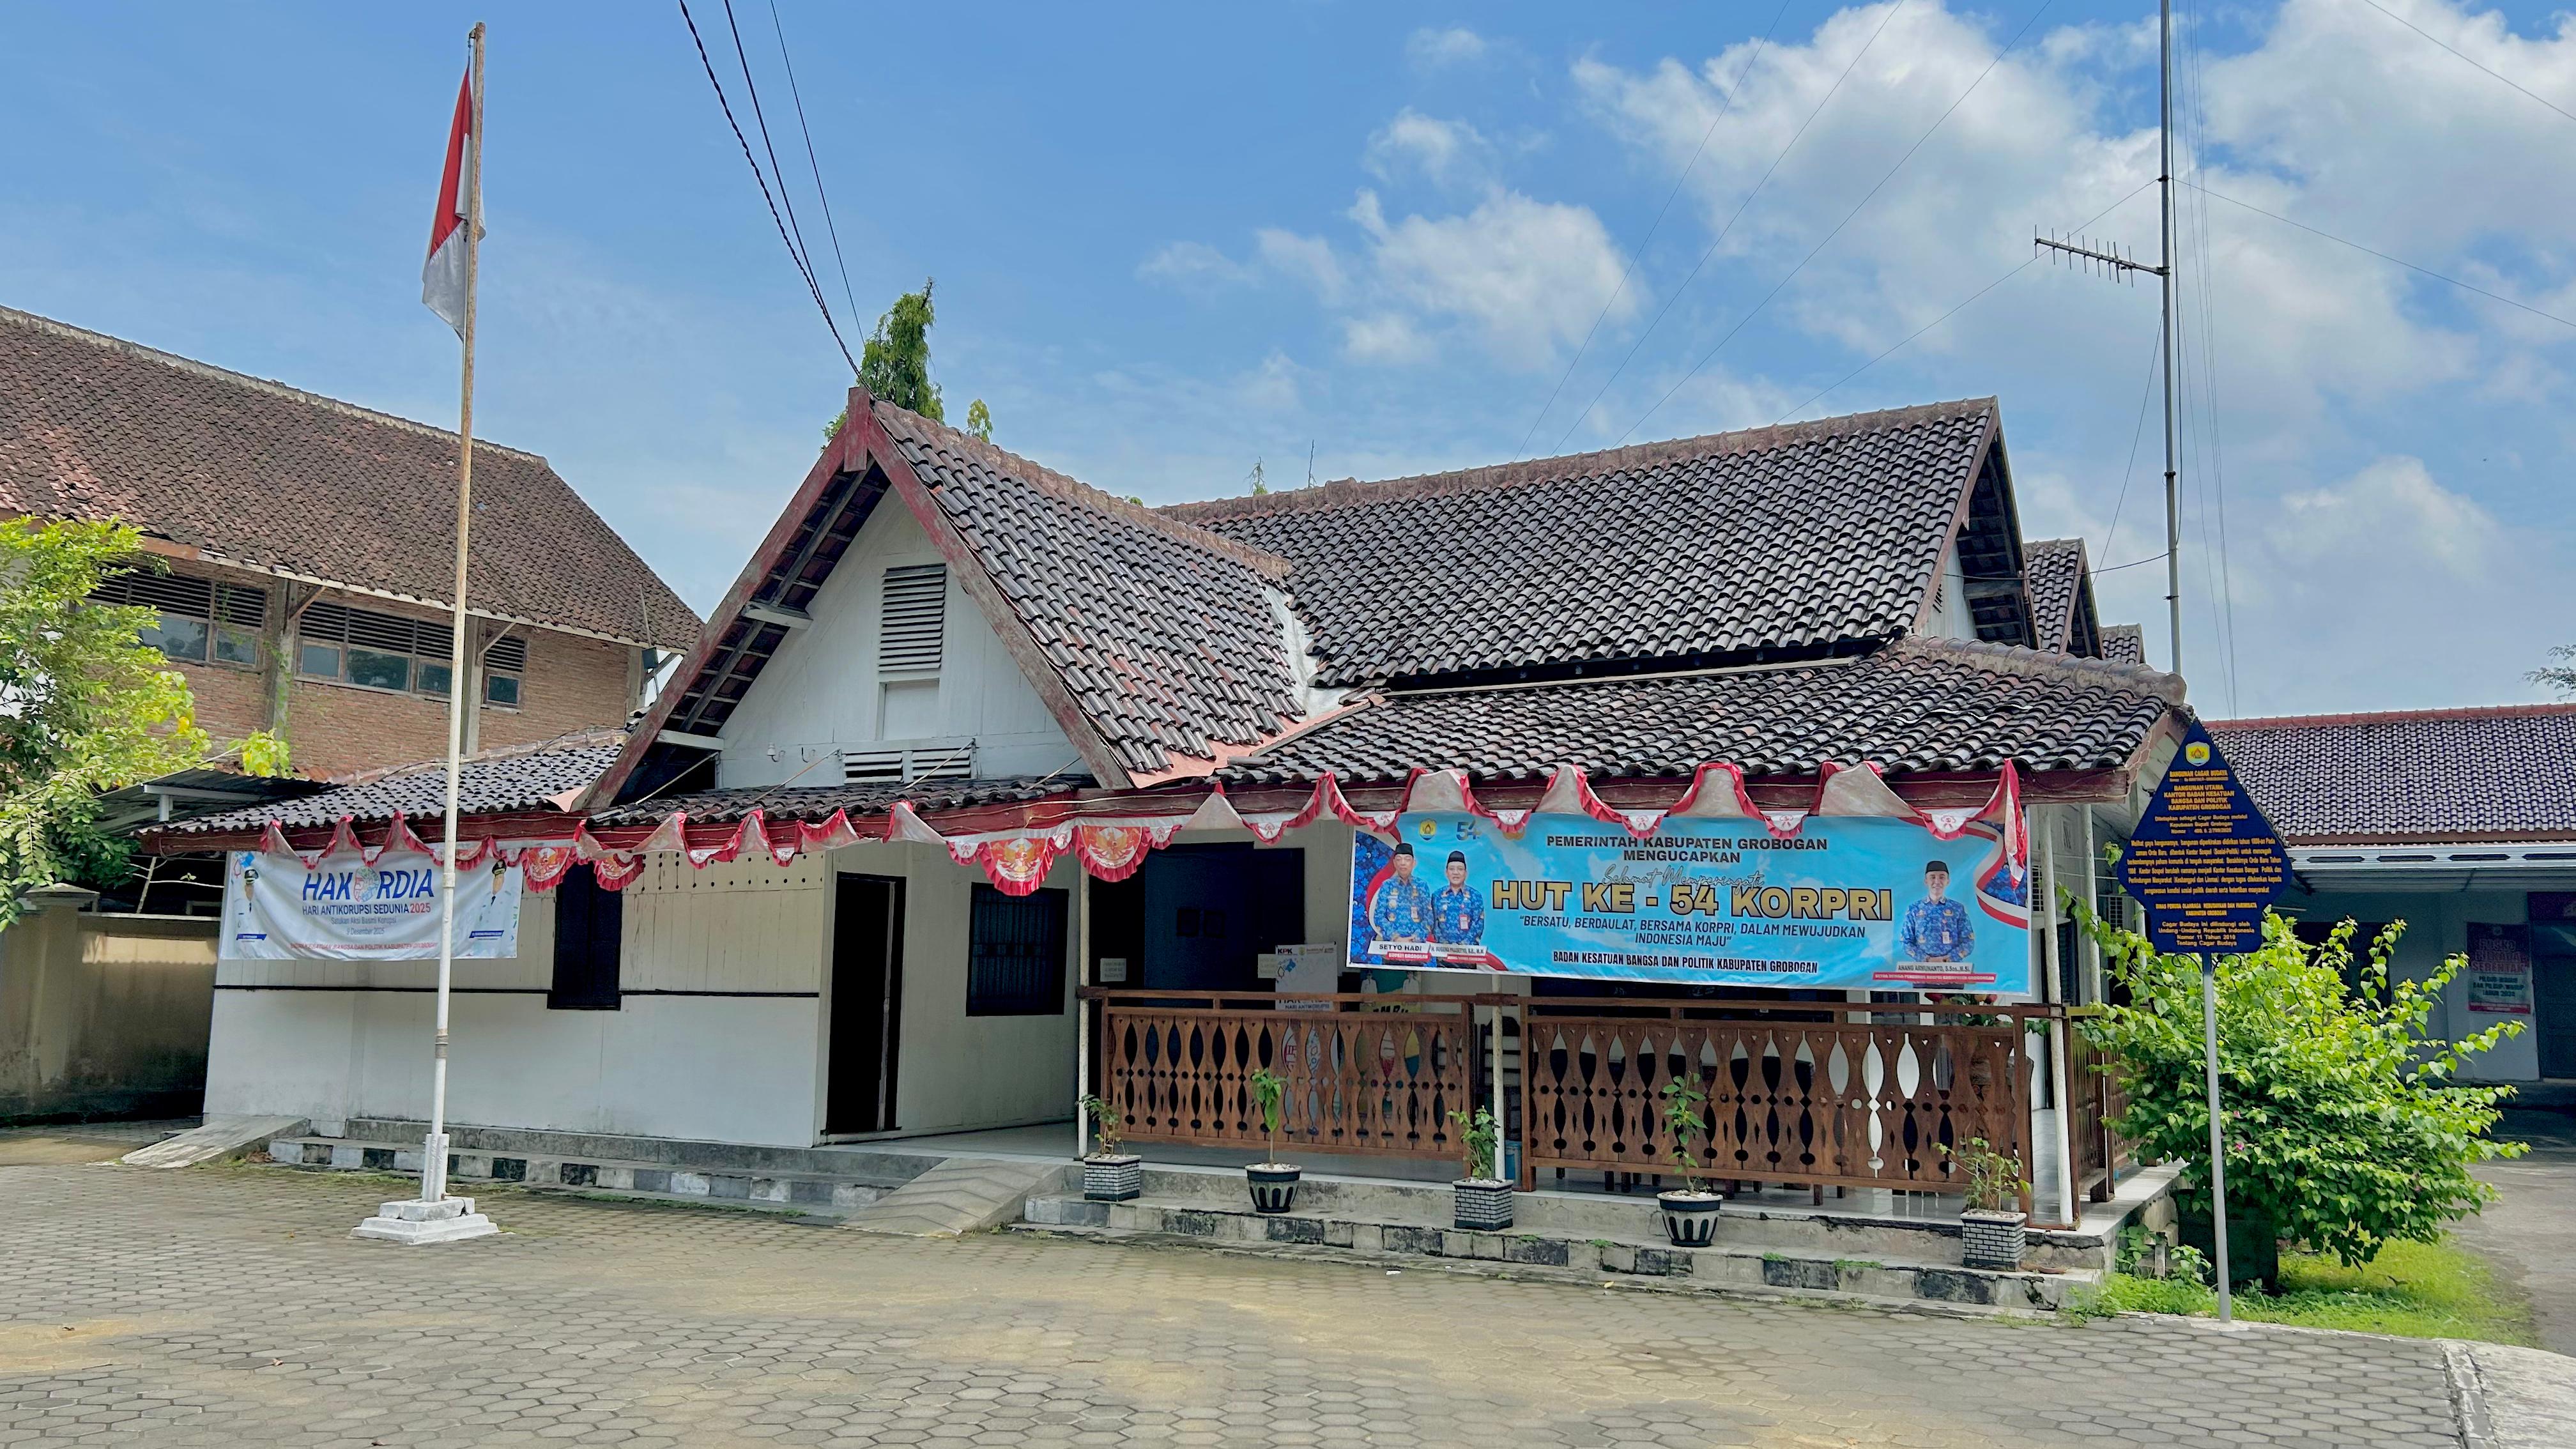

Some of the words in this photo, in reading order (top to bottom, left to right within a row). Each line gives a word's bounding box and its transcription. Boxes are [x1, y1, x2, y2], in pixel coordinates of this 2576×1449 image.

[1547, 836, 1637, 847] PEMERINTAH
[1644, 837, 1732, 849] KABUPATEN
[1738, 838, 1827, 850] GROBOGAN
[1624, 850, 1740, 862] MENGUCAPKAN
[1602, 864, 1662, 888] Selamat
[1662, 864, 1765, 894] Memperingati
[1492, 880, 1572, 910] HUT
[1583, 882, 1635, 914] KE
[1646, 896, 1659, 907] -
[1669, 884, 1719, 916] 54
[1731, 886, 1892, 921] KORPRI
[302, 905, 319, 916] HARI
[321, 904, 372, 915] ANTIKORUPSI
[374, 903, 410, 914] SEDUNIA
[410, 903, 431, 913] 2025
[378, 916, 397, 925] Korupsi
[1575, 917, 1637, 931] BERDAULAT,
[1640, 919, 1692, 932] BERSAMA
[1695, 921, 1736, 935] KORPRI,
[1740, 924, 1779, 935] DALAM
[1782, 924, 1865, 938] MEWUJUDKAN
[1636, 932, 1693, 946] INDONESIA
[1554, 951, 1579, 963] BADAN
[1582, 953, 1623, 965] KESATUAN
[1627, 954, 1659, 967] BANGSA
[1662, 956, 1679, 967] DAN
[1682, 957, 1714, 969] POLITIK
[1717, 958, 1767, 971] KABUPATEN
[1770, 960, 1818, 973] GROBOGAN
